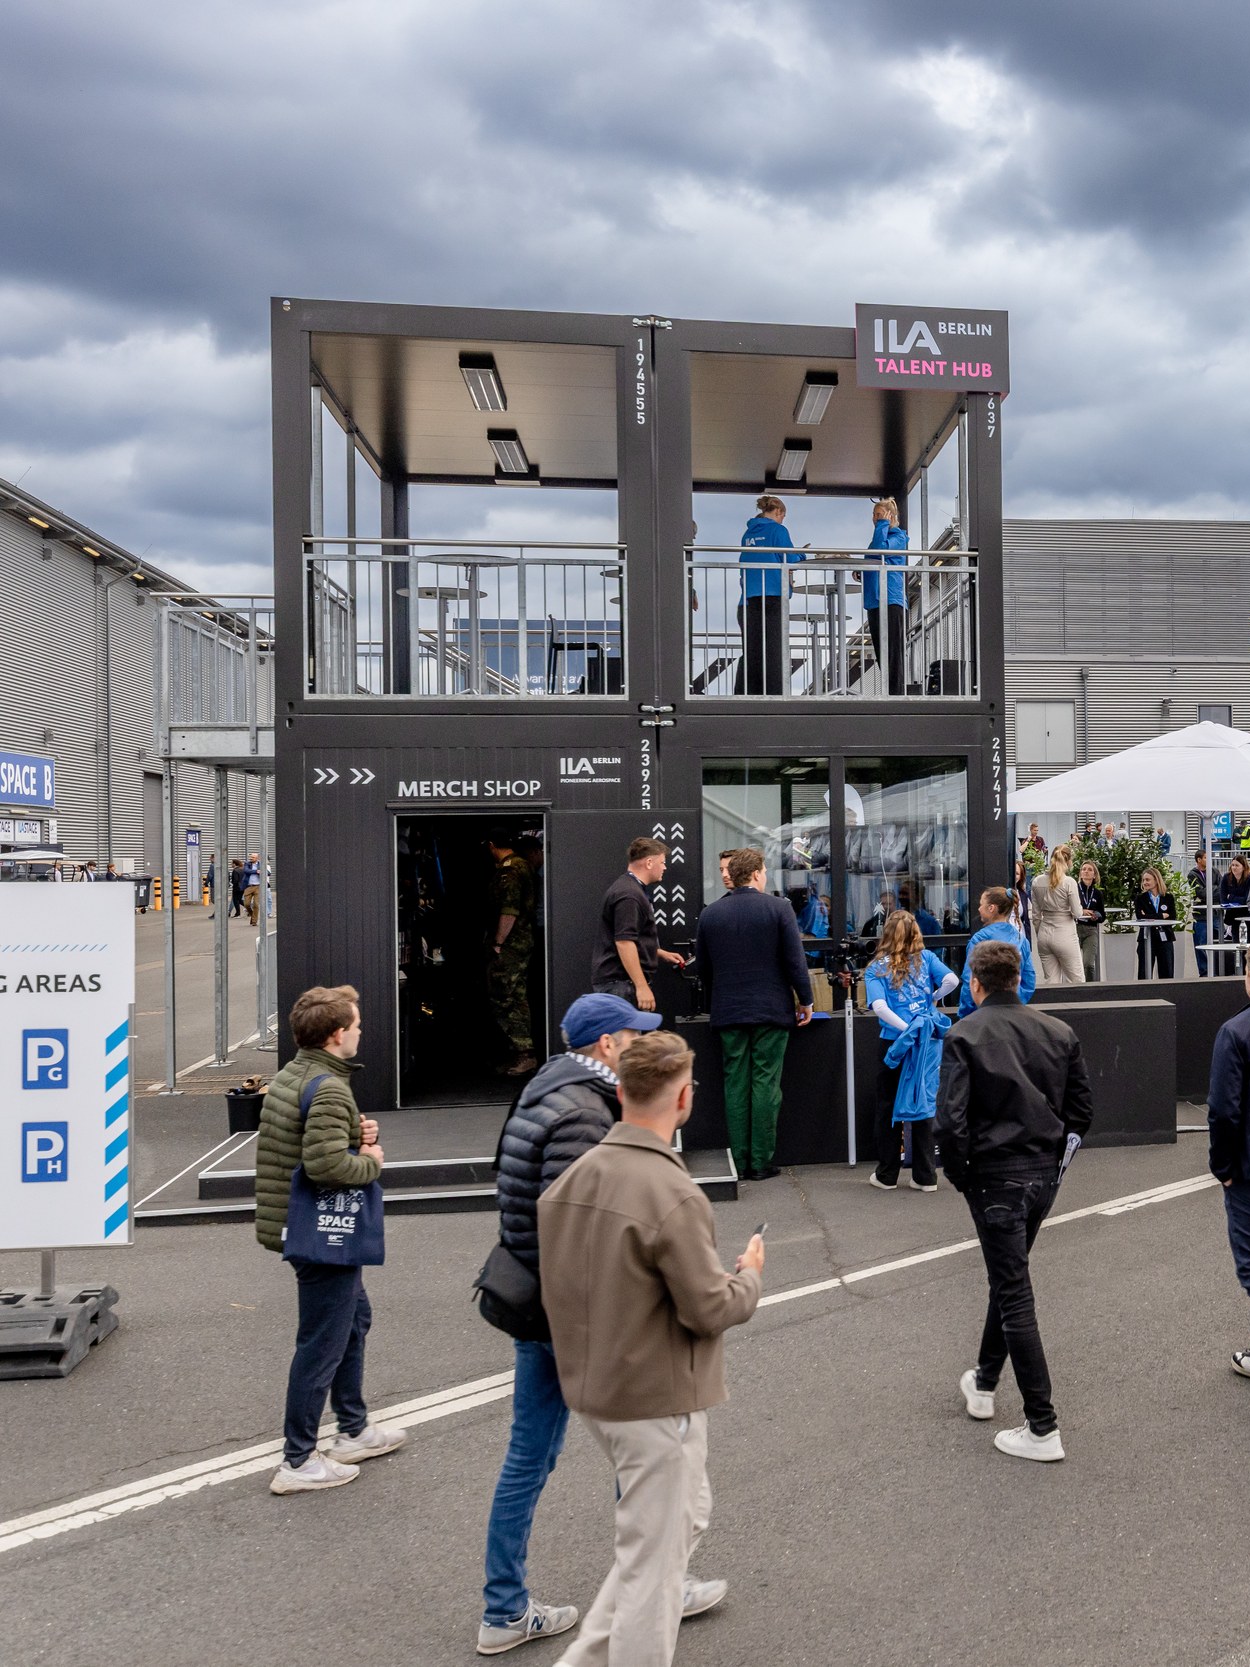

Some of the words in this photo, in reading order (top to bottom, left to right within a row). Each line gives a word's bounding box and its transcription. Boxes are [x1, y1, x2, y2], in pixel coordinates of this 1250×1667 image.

[874, 318, 941, 356] ILA
[938, 321, 992, 337] BERLIN
[636, 338, 646, 425] 194555
[875, 357, 948, 376] TALENT
[952, 361, 993, 378] HUB
[987, 392, 996, 438] 637
[560, 757, 595, 775] ILA
[992, 737, 1001, 821] 247417
[0, 762, 37, 796] SPACE
[44, 765, 52, 801] B
[398, 780, 477, 797] MERCH
[484, 780, 542, 797] SHOP
[15, 973, 102, 993] AREAS
[317, 1214, 356, 1228] SPACE
